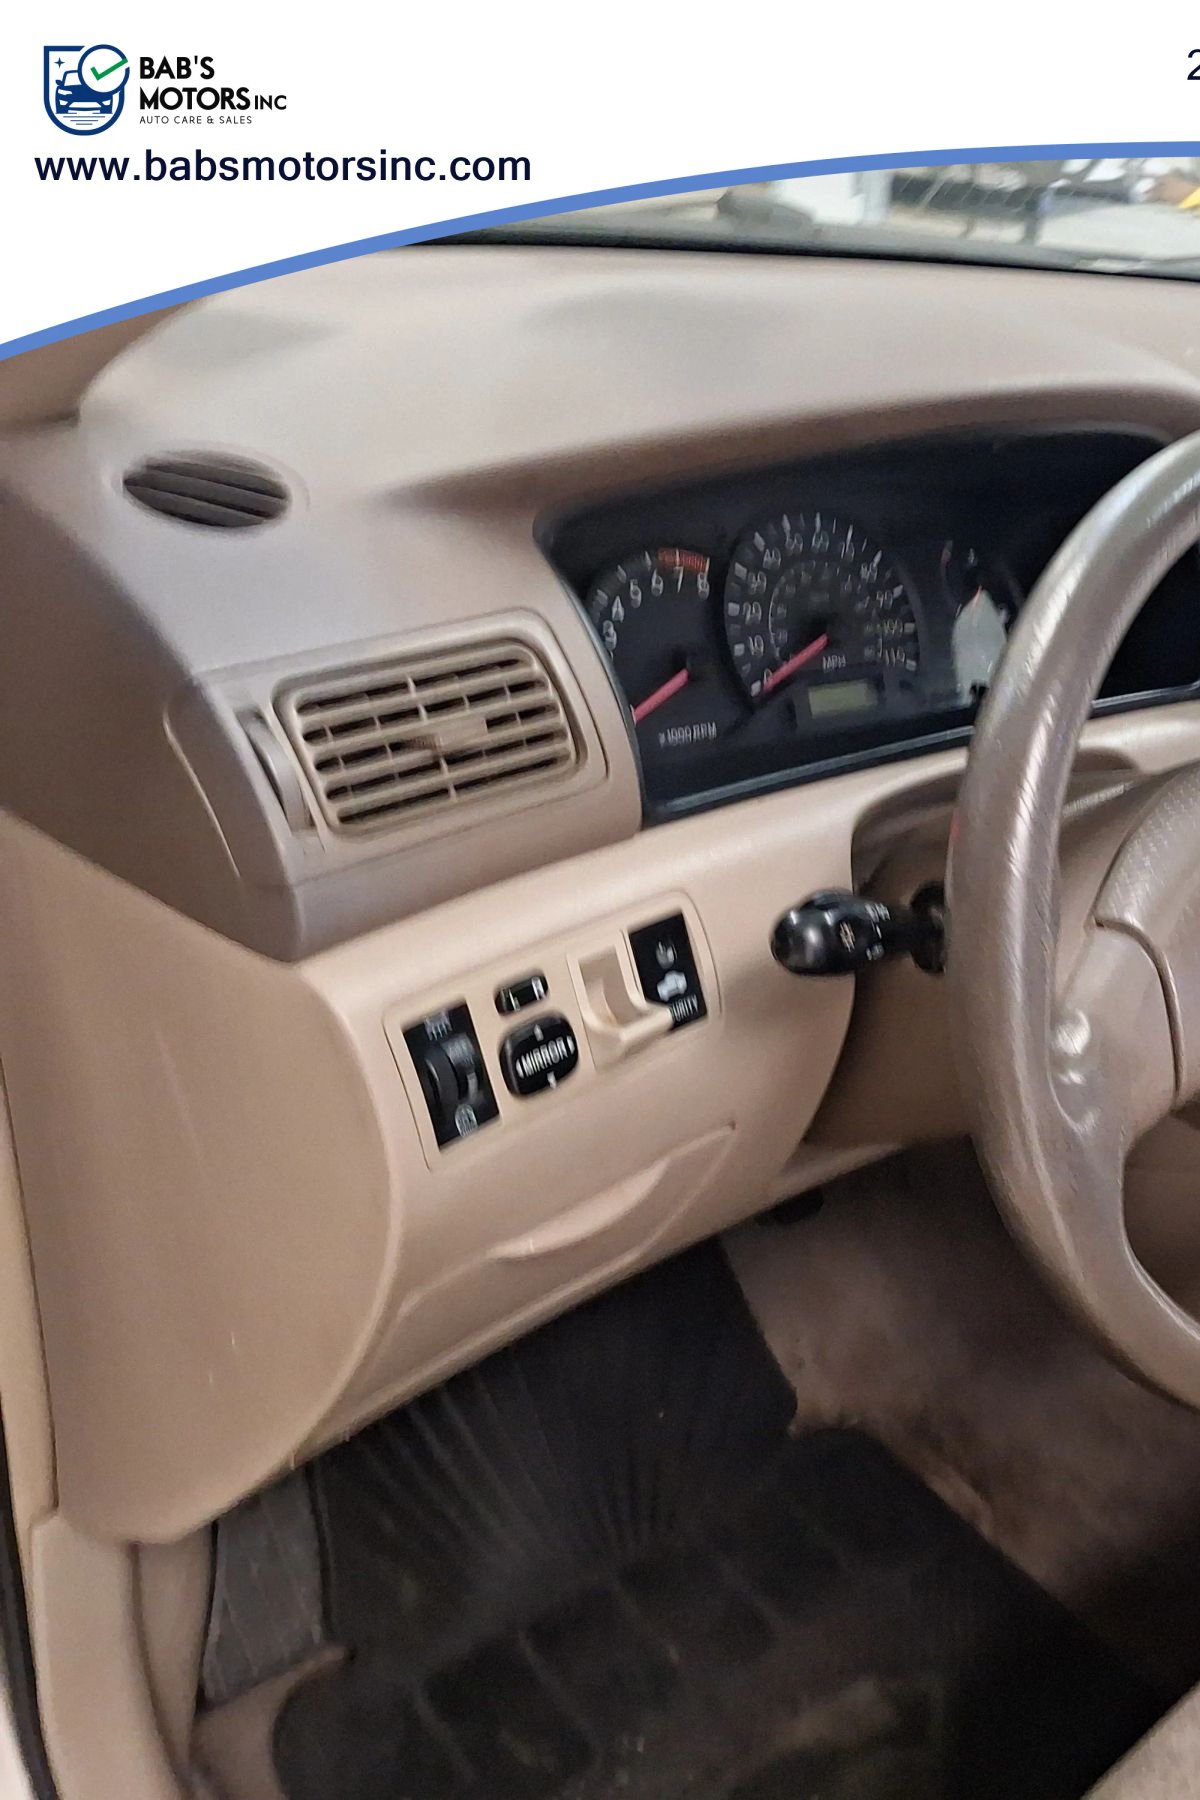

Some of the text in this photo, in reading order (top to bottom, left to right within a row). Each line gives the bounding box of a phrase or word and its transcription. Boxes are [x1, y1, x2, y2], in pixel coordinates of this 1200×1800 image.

[612, 596, 625, 622] 4
[630, 579, 642, 608] 5
[651, 569, 664, 597] 6
[673, 567, 684, 593] 7
[697, 572, 710, 600] 8
[521, 1036, 568, 1078] MIRROR
